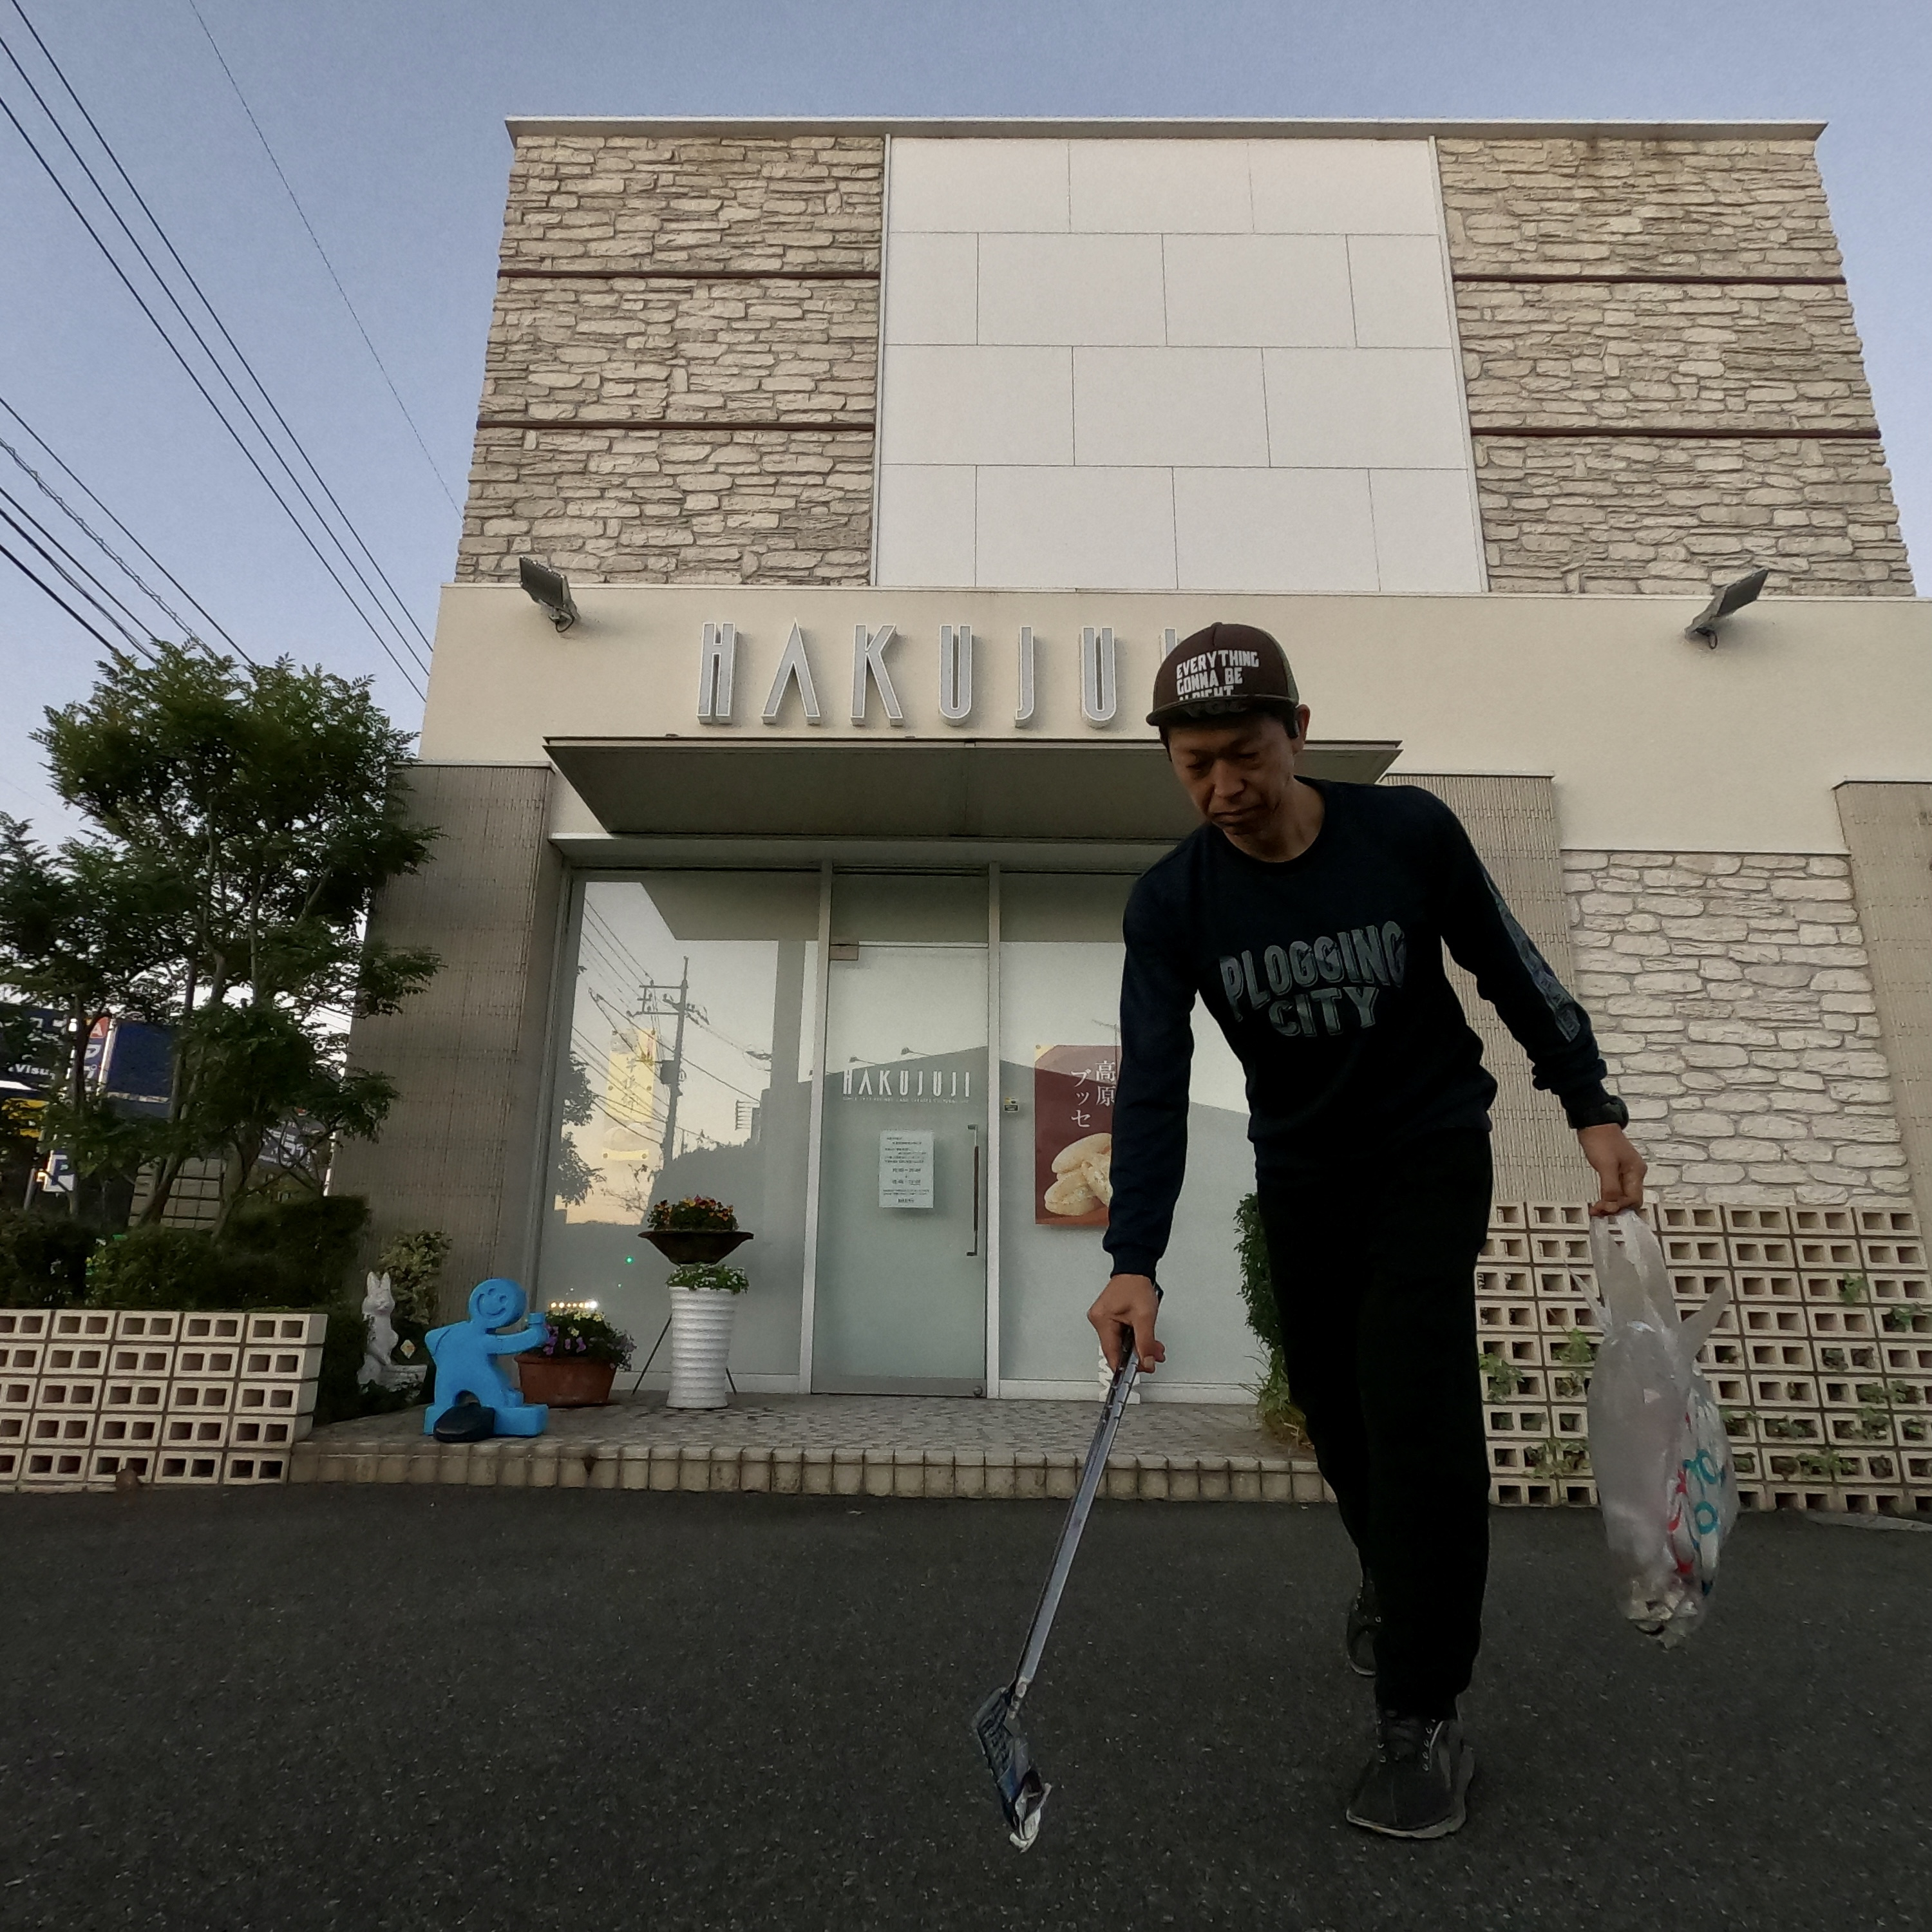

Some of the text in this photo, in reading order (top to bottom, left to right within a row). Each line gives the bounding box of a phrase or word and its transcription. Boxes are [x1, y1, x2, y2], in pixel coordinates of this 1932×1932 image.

[696, 617, 1177, 729] HAKUJU
[1176, 649, 1260, 680] EVERYTHING
[1176, 667, 1243, 696] GONNA BE
[1218, 920, 1407, 1024] PLOGGING
[1268, 985, 1379, 1038] CITY
[842, 1068, 971, 1097] HAKUJUJI
[1070, 1068, 1092, 1128] ブッセ
[1095, 1060, 1116, 1107] 高原
